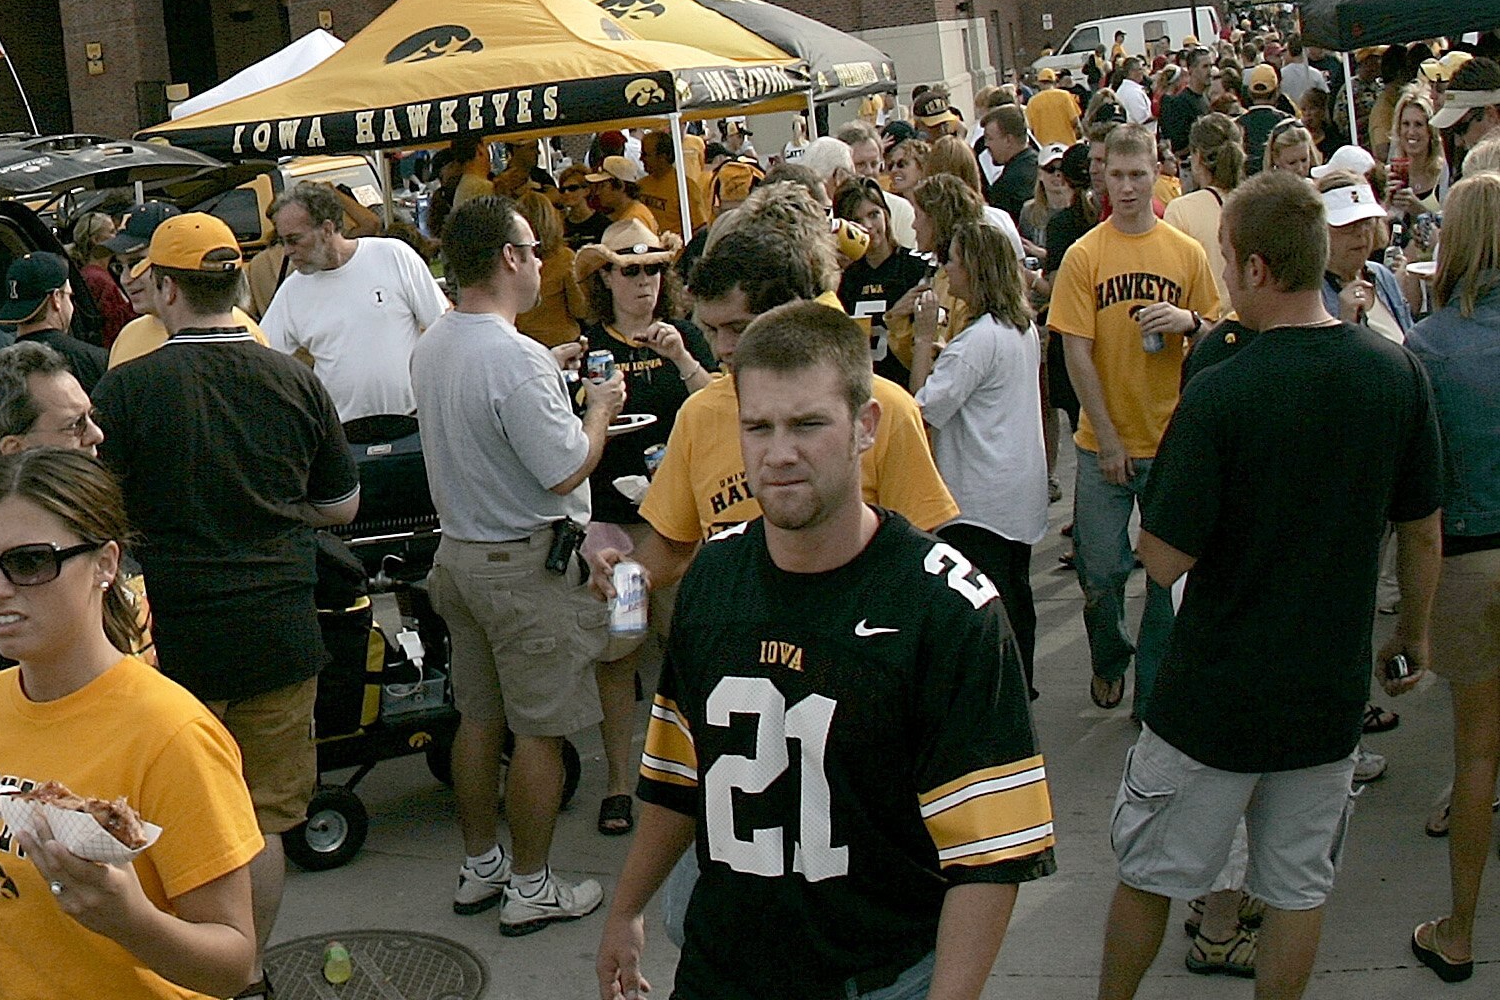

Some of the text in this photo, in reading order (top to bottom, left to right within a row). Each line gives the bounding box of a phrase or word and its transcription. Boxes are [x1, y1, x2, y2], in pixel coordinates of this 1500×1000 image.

[232, 85, 559, 154] IOWA HAWKEYES
[759, 640, 804, 672] IOWA
[705, 675, 849, 883] 21
